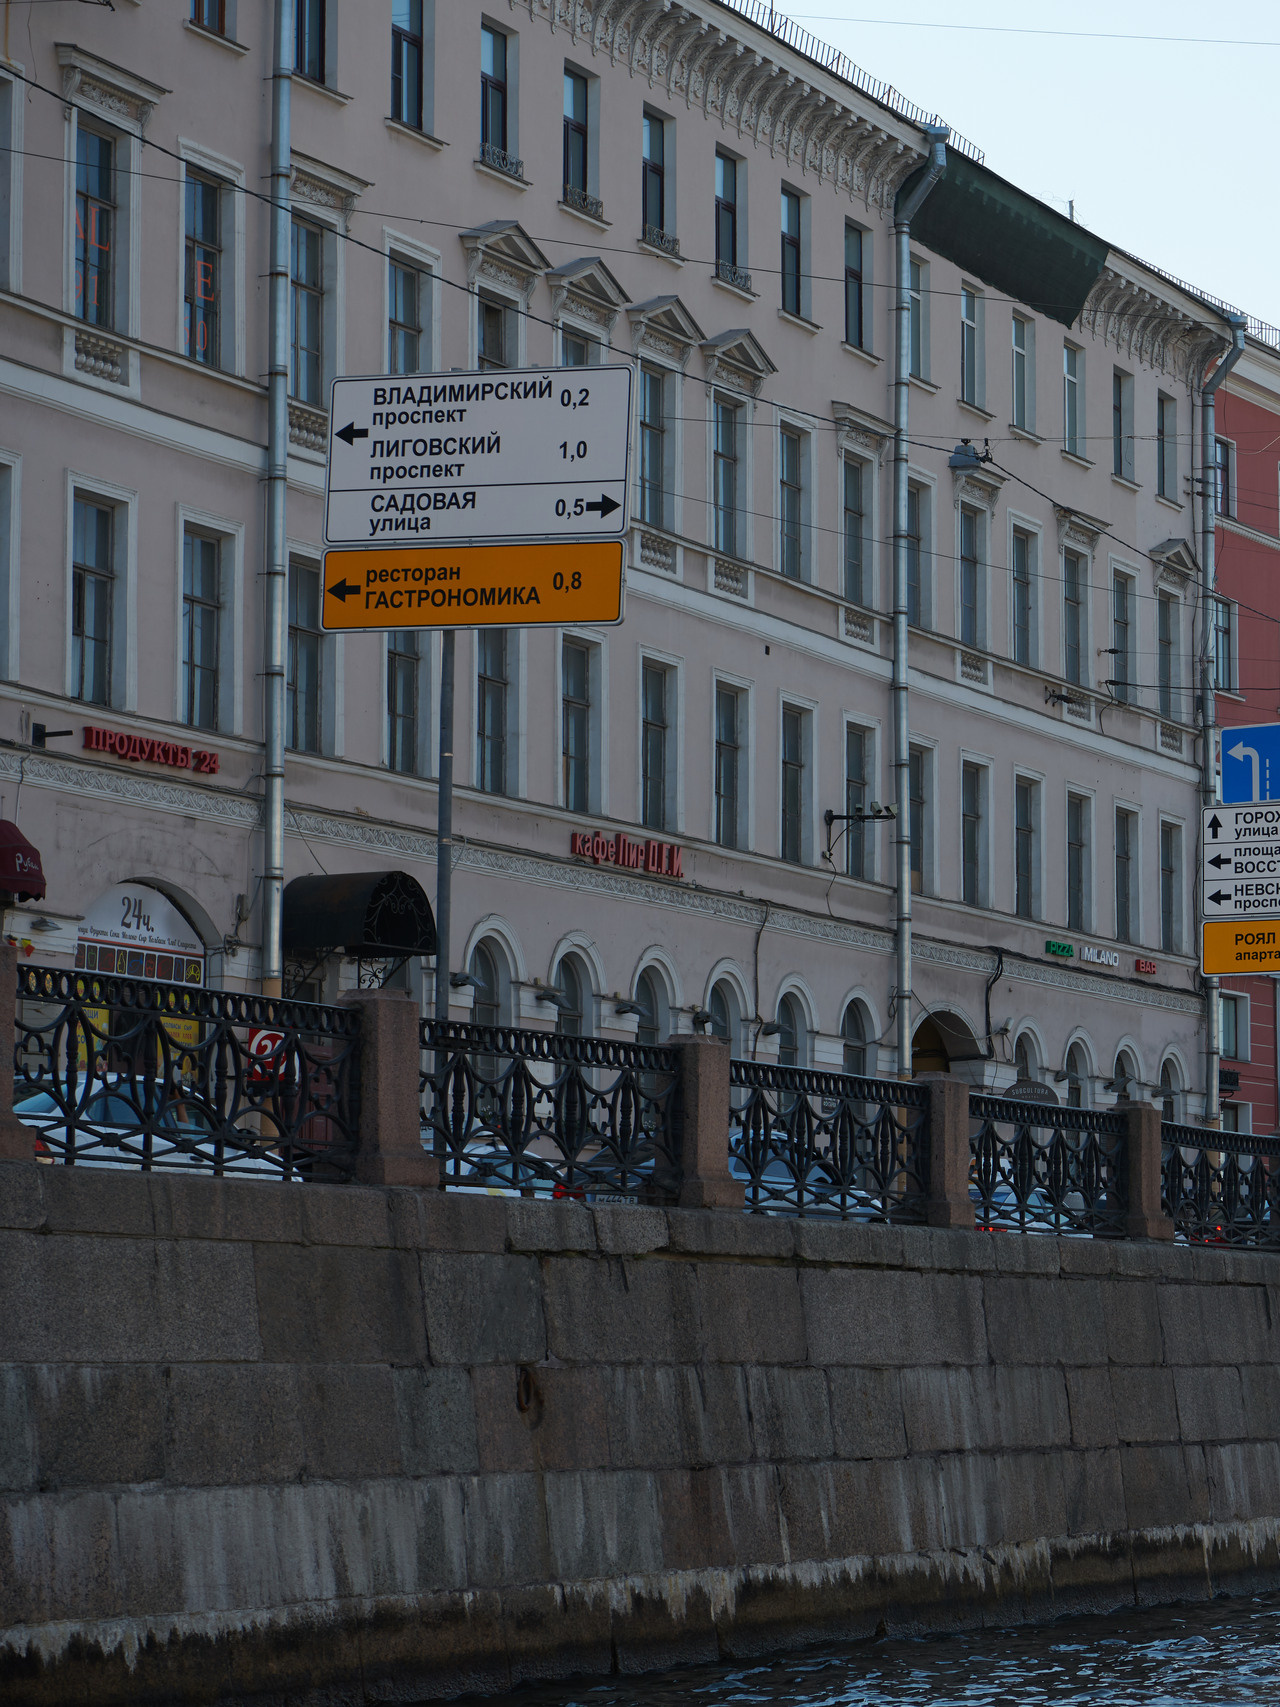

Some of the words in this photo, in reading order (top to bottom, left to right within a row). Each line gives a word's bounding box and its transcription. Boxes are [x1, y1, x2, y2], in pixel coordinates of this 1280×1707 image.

[373, 376, 553, 407] ВЛАДИМИРСКИЙ
[560, 388, 590, 410] 0,2
[372, 408, 467, 429] проспект
[370, 431, 501, 458] ЛИГОВСКИЙ
[559, 440, 588, 462] 1,0
[370, 463, 465, 483] проспект
[371, 491, 476, 515] САДОВАЯ
[555, 498, 585, 519] 0,5
[369, 515, 431, 535] улица
[366, 566, 461, 586] ресторан
[553, 571, 582, 593] 0,8
[365, 586, 541, 609] ГАСТРОНОМИКА
[86, 727, 192, 768] ПРОДУКТЫ
[199, 749, 220, 774] 24
[1235, 825, 1279, 839] улица
[573, 831, 616, 864] кафе
[617, 834, 645, 868] Пир
[1235, 932, 1276, 946] РОЯЛ
[1047, 941, 1074, 957] PIZZA
[1083, 946, 1119, 966] MILANO
[1138, 959, 1157, 975] BAR
